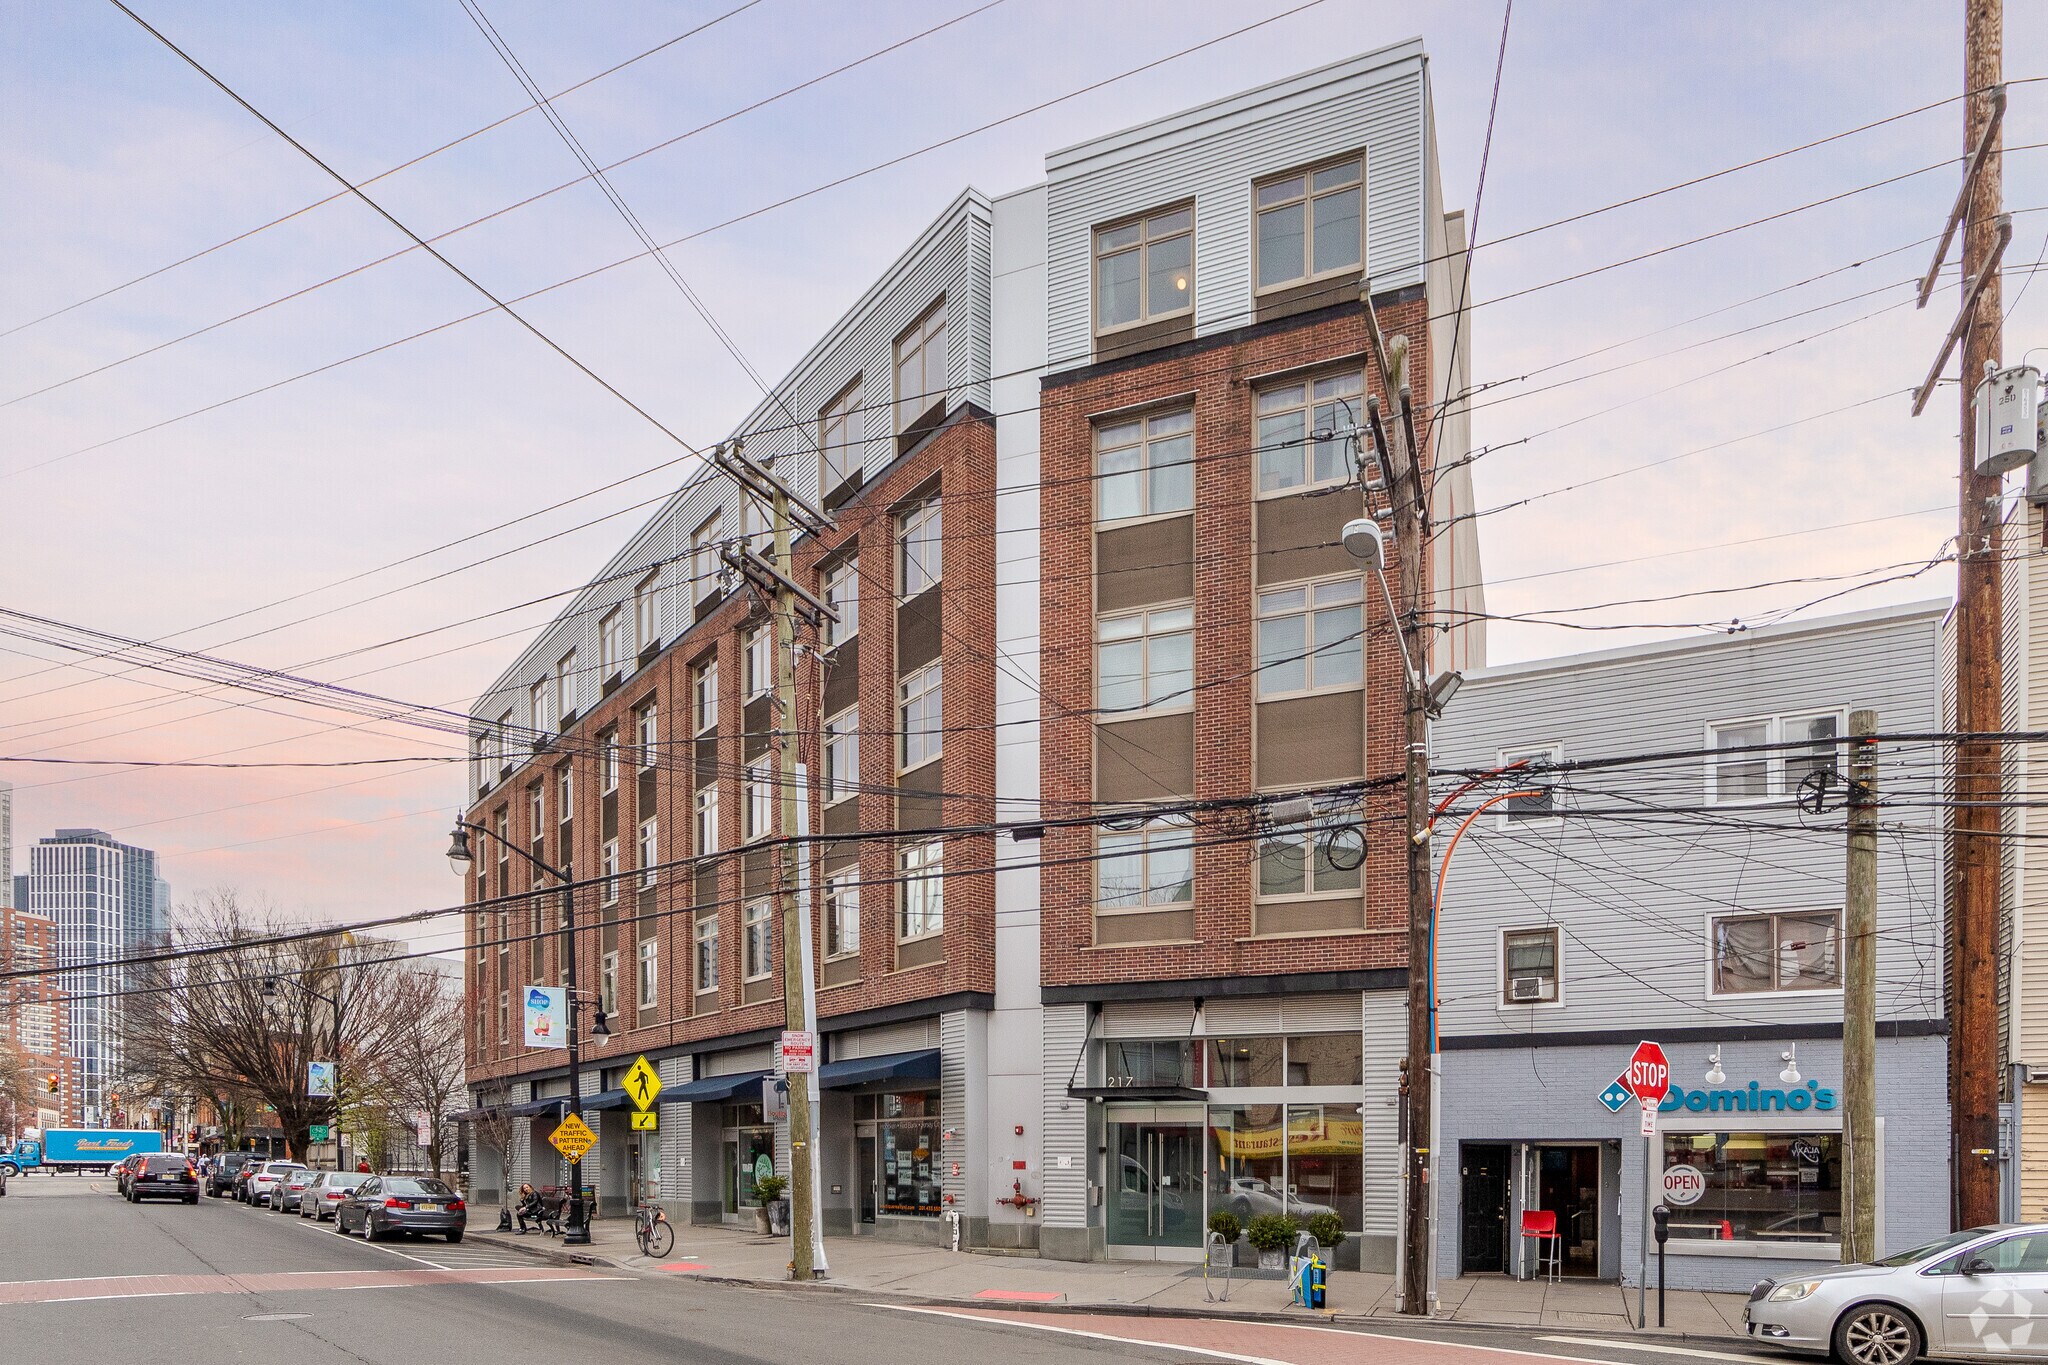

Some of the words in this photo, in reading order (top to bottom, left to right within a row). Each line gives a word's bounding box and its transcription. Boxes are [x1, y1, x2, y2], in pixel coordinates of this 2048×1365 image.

[1108, 1076, 1133, 1088] 217
[1633, 1060, 1667, 1088] STOP
[1658, 1079, 1838, 1112] Domino's
[1663, 1174, 1700, 1190] OPEN
